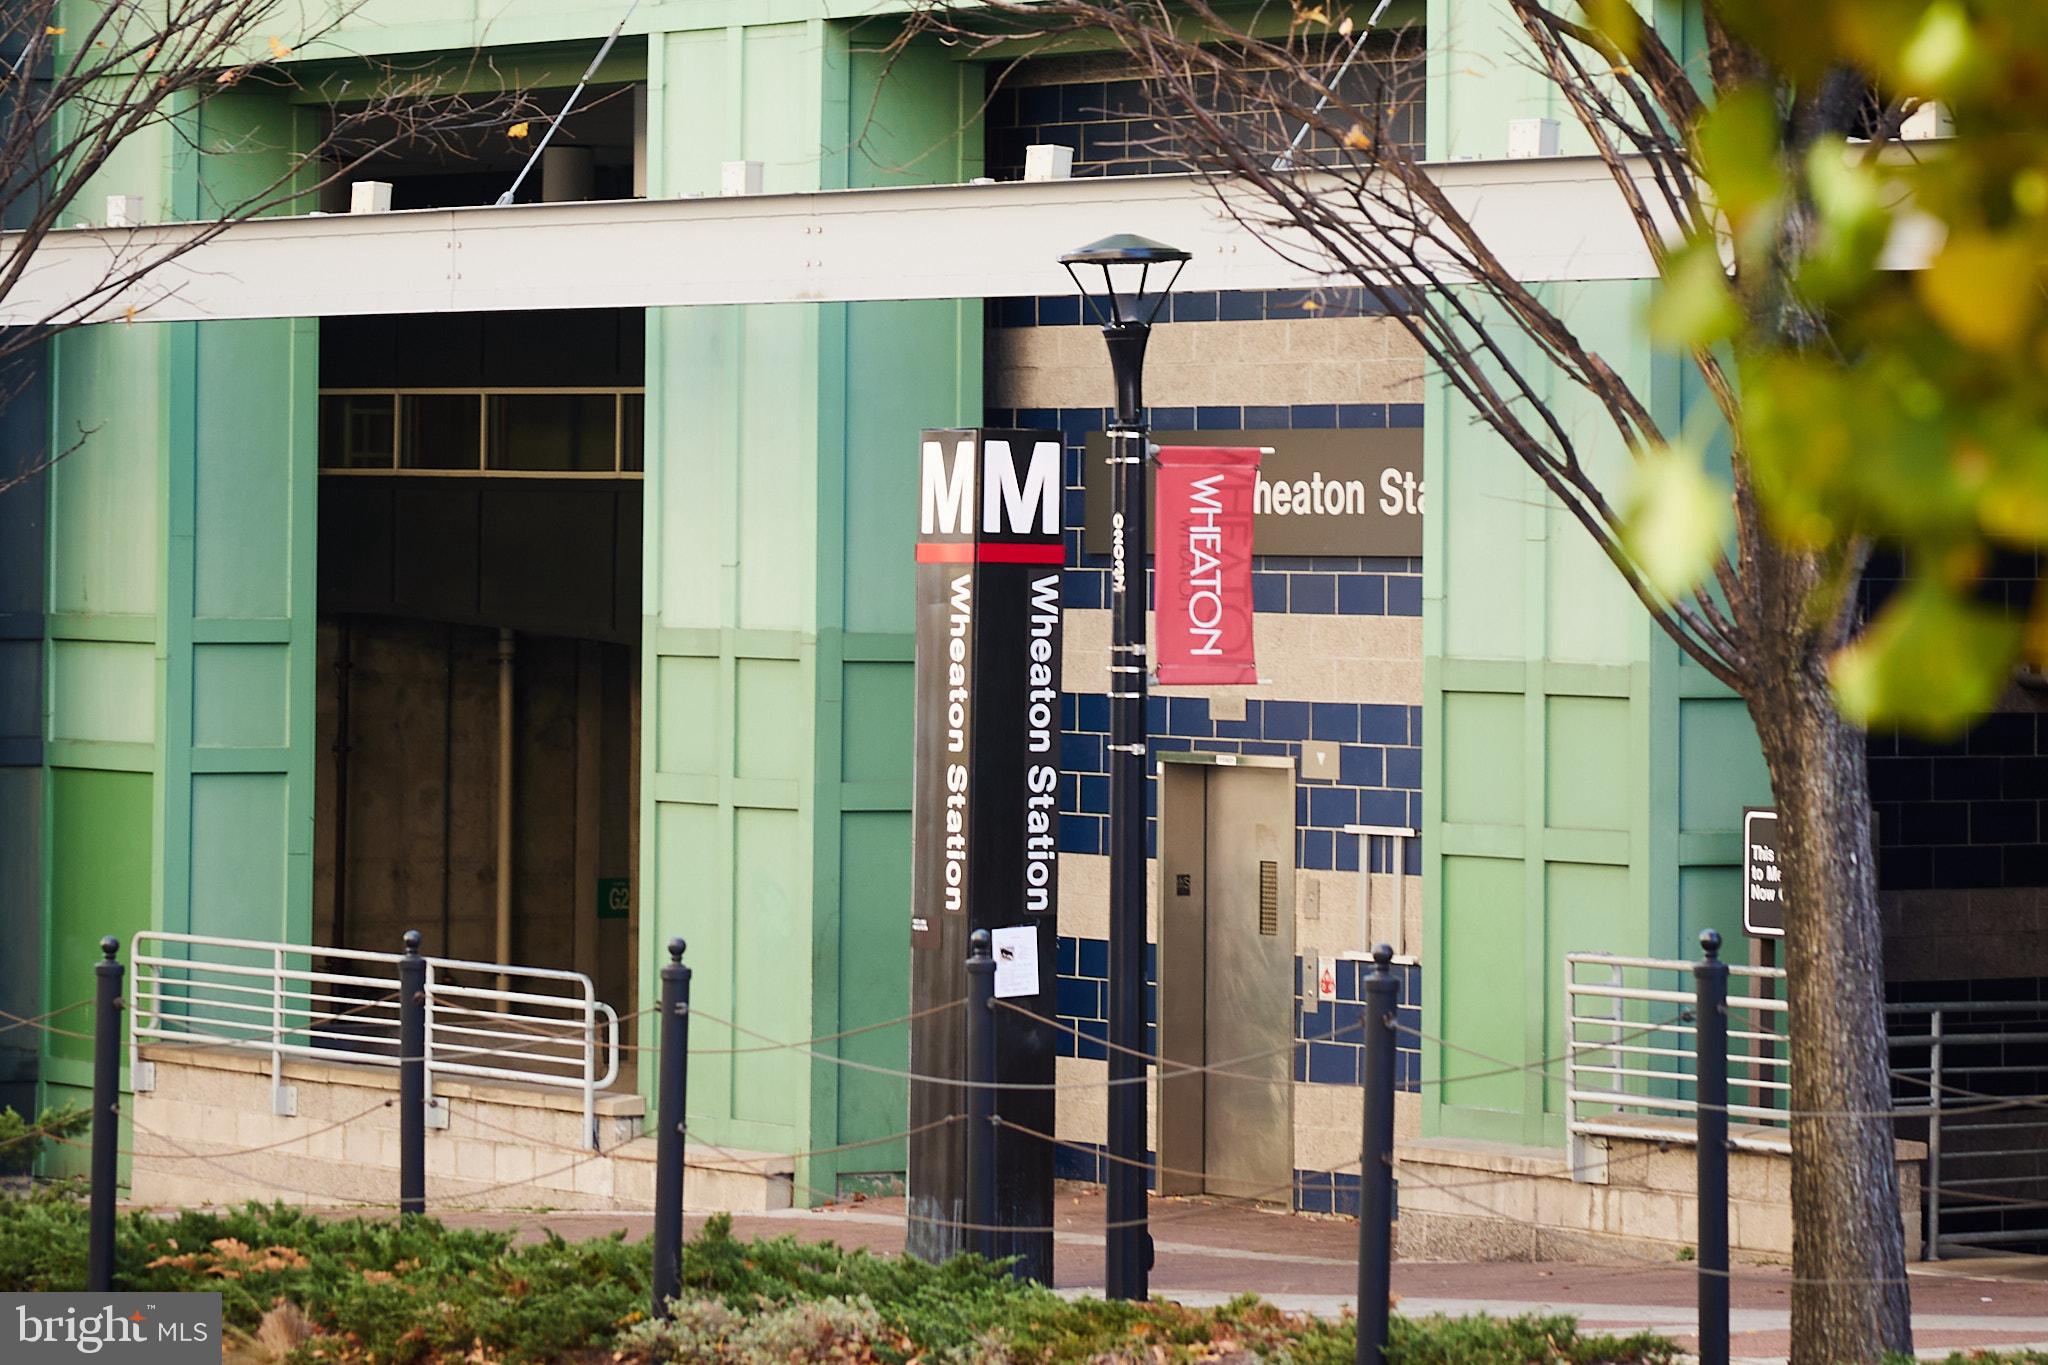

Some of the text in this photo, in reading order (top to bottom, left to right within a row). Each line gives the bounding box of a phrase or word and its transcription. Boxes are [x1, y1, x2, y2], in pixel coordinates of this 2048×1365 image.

[921, 441, 975, 534] M
[983, 440, 1061, 535] M
[1253, 470, 1366, 516] heaton
[1188, 473, 1225, 656] WHEATON
[945, 574, 972, 911] Wheaton Station
[1026, 574, 1060, 911] Wheaton Station
[1751, 844, 1775, 863] This
[1751, 864, 1764, 881] to
[1751, 883, 1776, 902] Now
